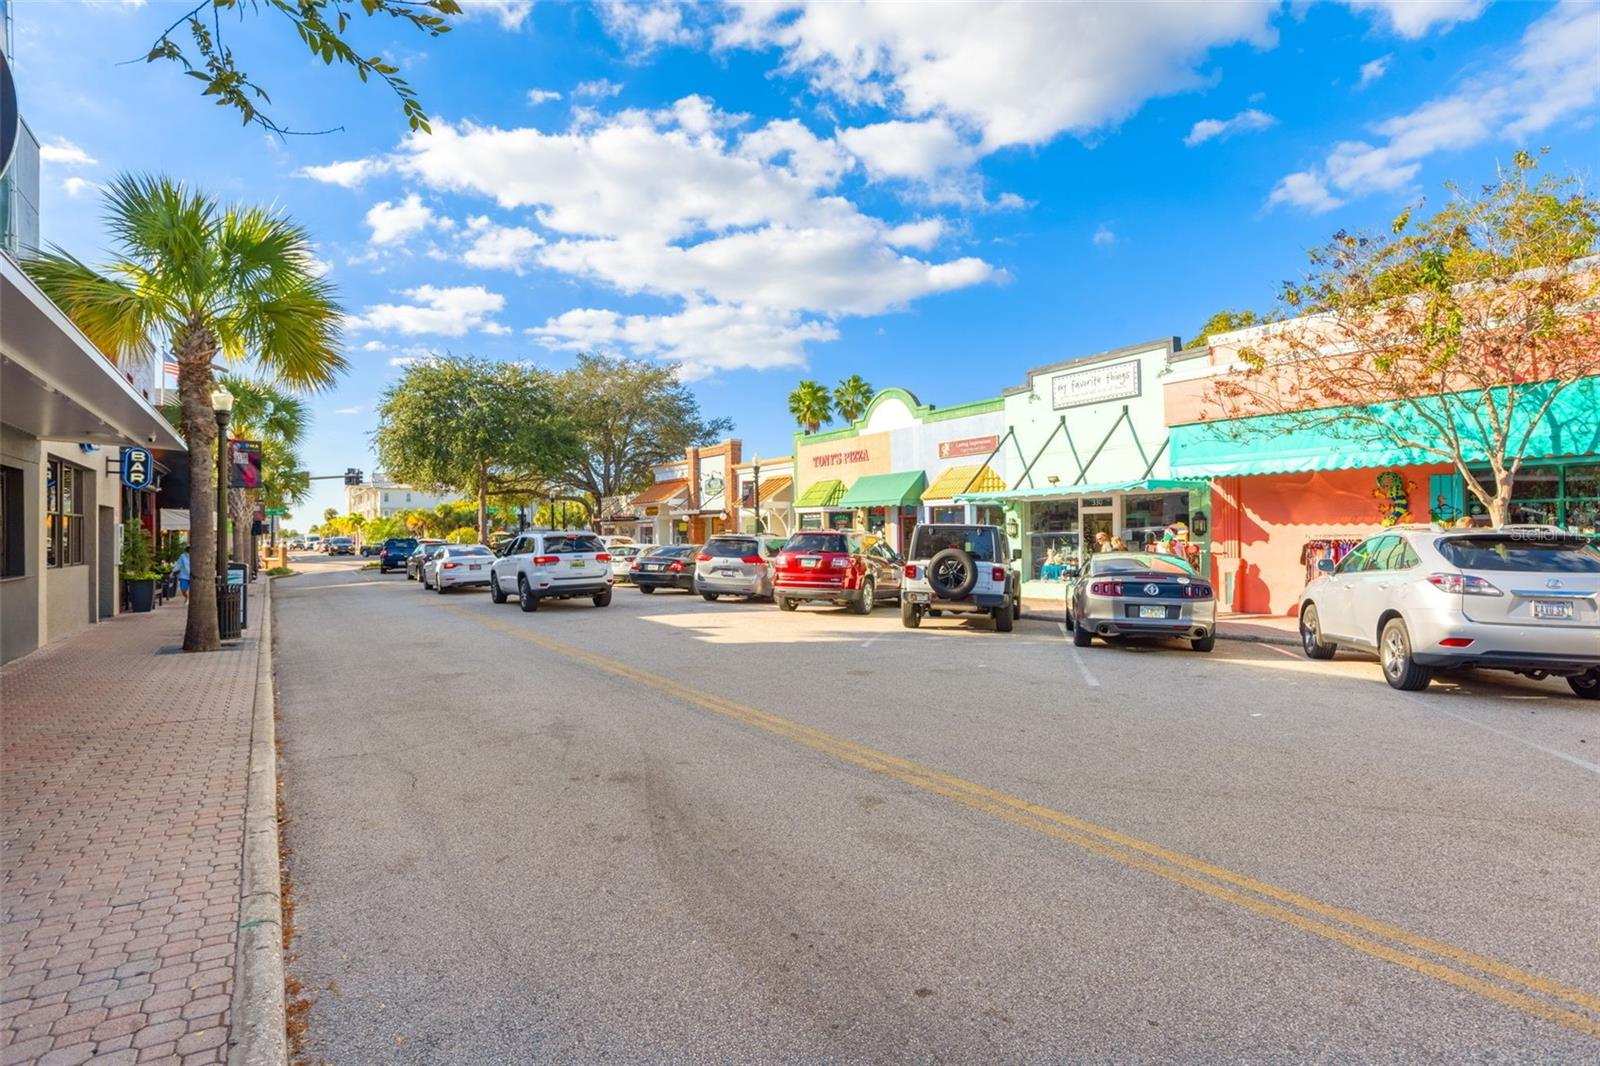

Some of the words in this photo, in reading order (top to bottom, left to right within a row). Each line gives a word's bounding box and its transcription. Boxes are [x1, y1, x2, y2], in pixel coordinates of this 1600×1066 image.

[1071, 376, 1102, 393] favorite
[1105, 370, 1130, 385] things
[130, 451, 146, 483] BAR
[812, 452, 842, 468] TONY'S
[843, 449, 870, 464] PIZZA
